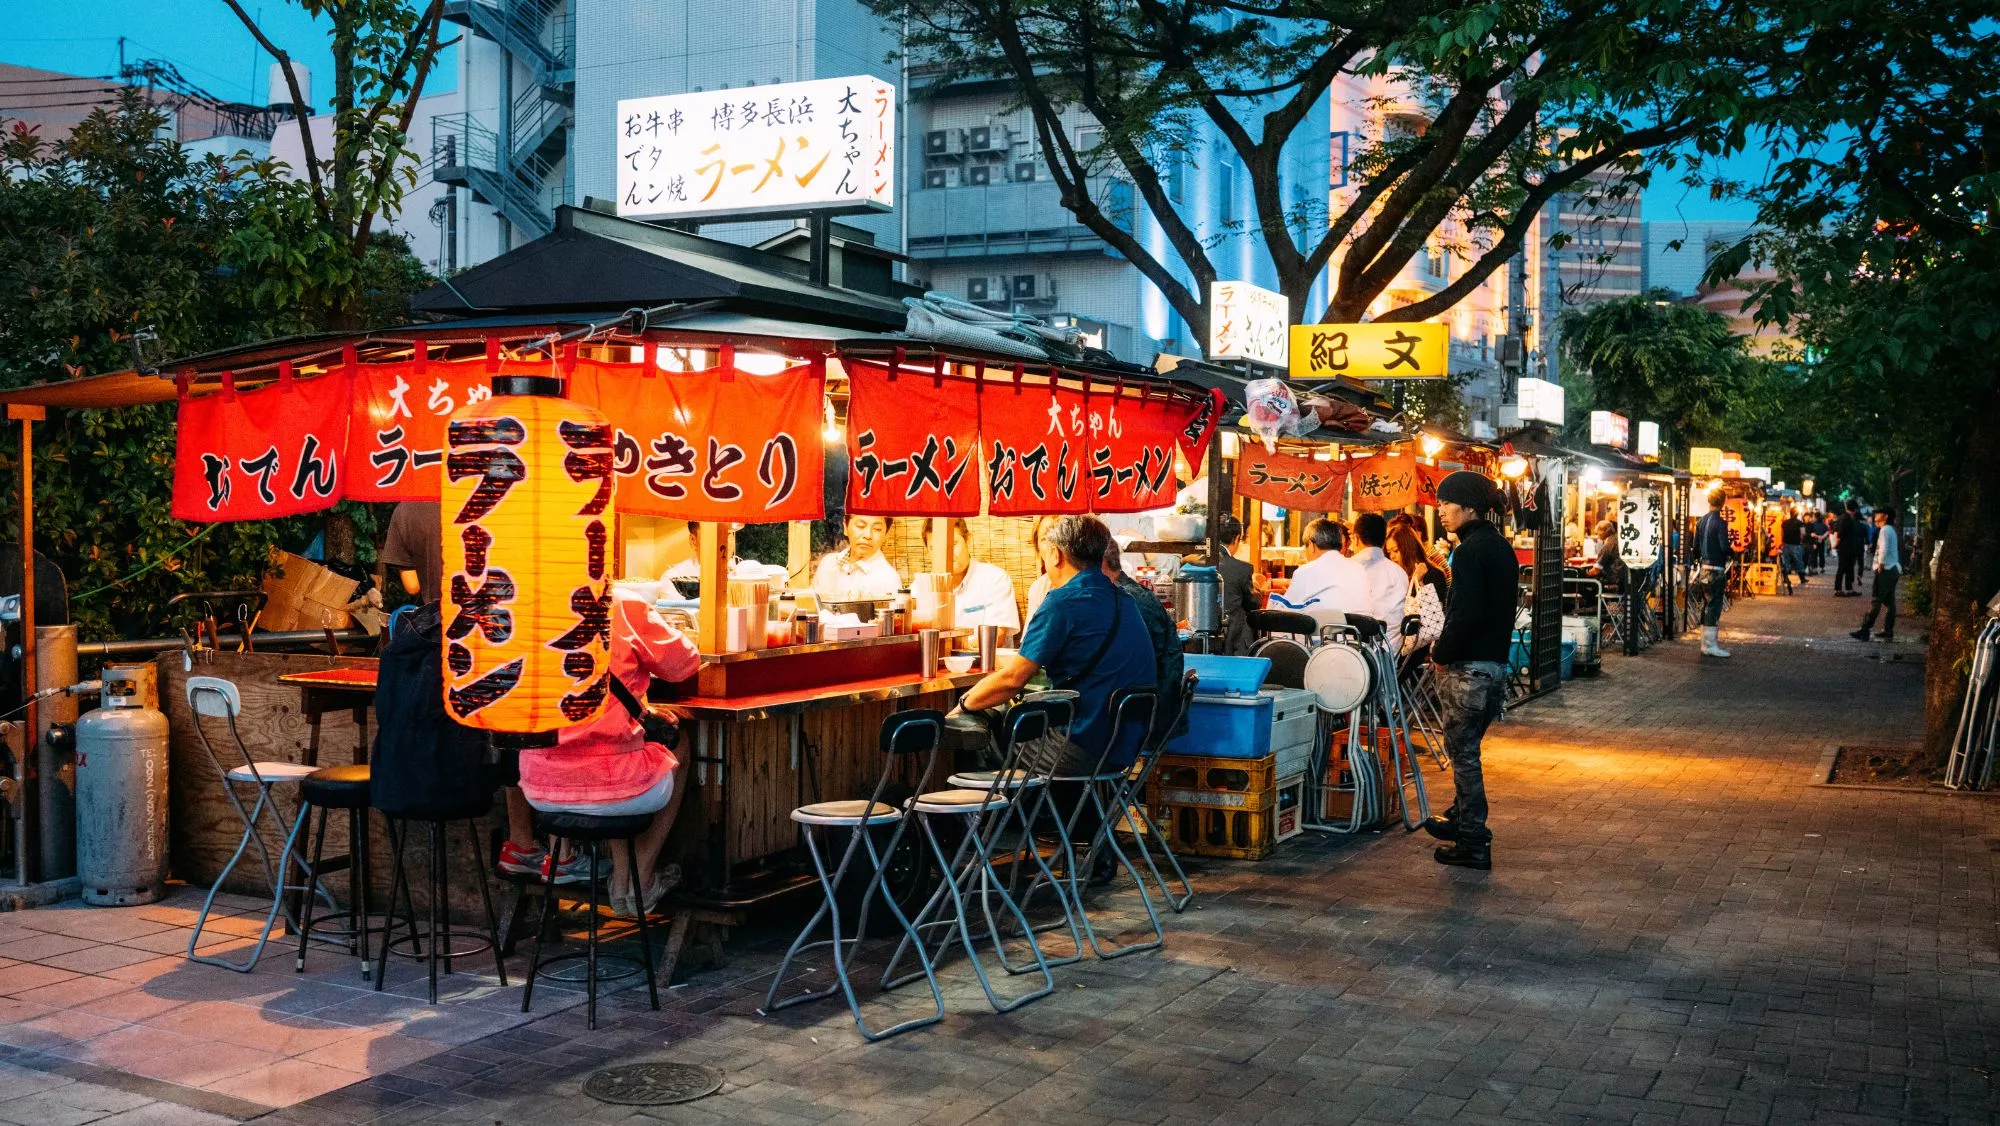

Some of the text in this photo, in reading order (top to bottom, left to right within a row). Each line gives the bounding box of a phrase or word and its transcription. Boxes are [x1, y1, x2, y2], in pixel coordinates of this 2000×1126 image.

[711, 95, 815, 131] 博多長浜
[835, 86, 862, 195] 大ちゃん
[874, 89, 890, 195] ラーメン
[625, 112, 641, 206] おでん
[695, 135, 831, 203] ラーメン
[1217, 286, 1234, 354] ラーメン
[1310, 331, 1422, 371] 紀文
[1047, 396, 1123, 440] 大ちゃん
[200, 434, 336, 511] おでん
[614, 431, 798, 510] やきとり
[853, 429, 977, 500] ラーメン
[988, 440, 1079, 504] おでん
[1091, 445, 1174, 500] ラーメン
[1248, 463, 1334, 497] ラーメン
[1358, 471, 1413, 498] 焼ラーメン
[1620, 494, 1640, 557] らーめん
[445, 416, 528, 719] ラーメン
[547, 419, 614, 723] ラーメン
